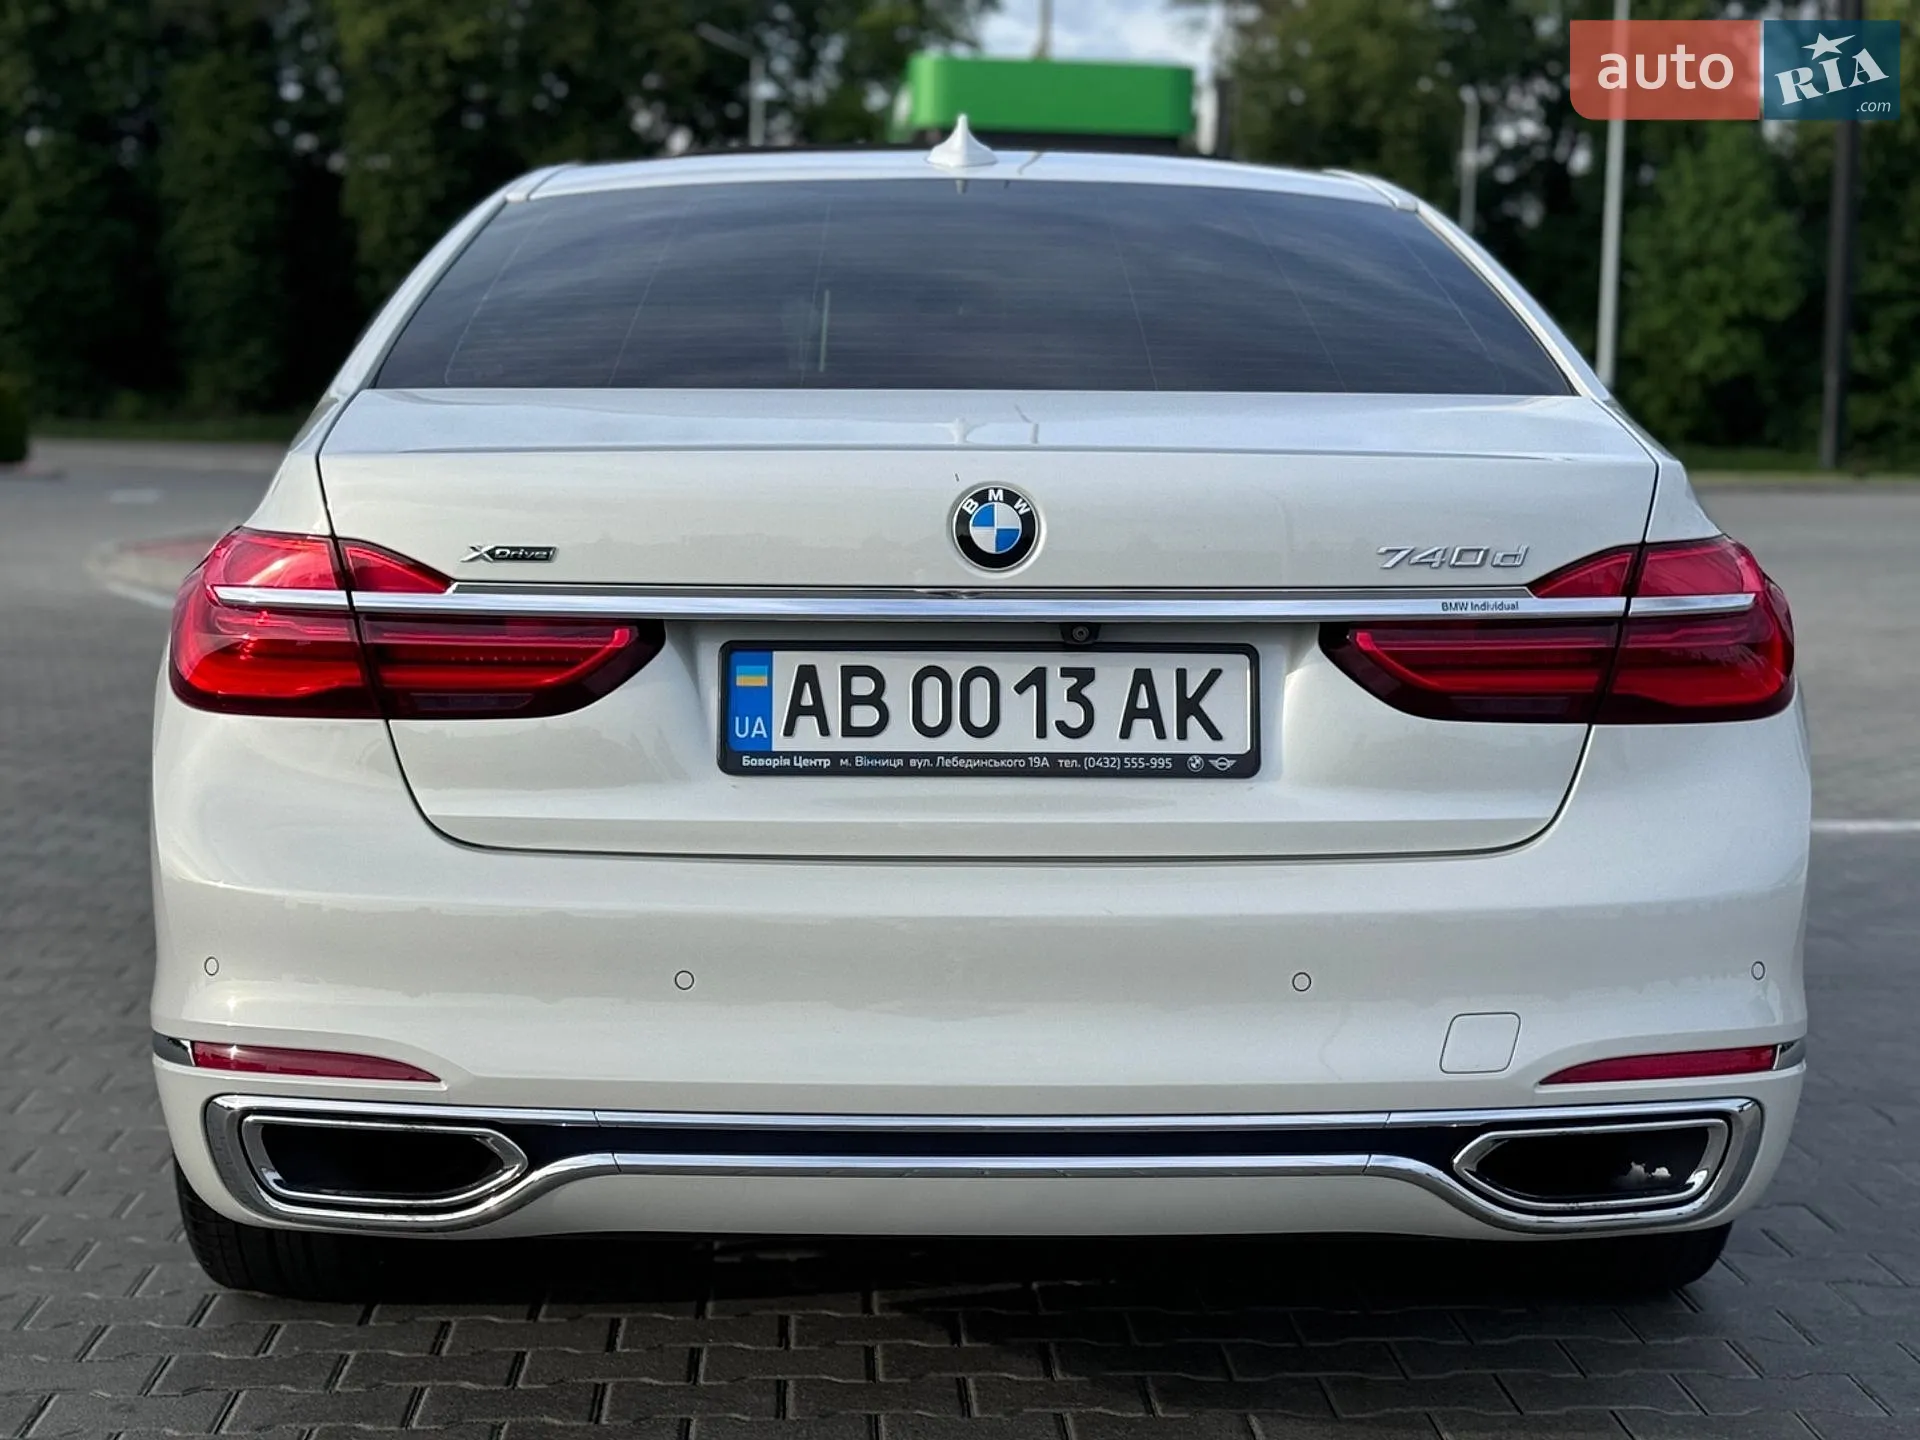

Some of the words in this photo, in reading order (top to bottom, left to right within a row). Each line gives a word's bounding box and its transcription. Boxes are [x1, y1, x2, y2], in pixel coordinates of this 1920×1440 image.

[962, 489, 1031, 516] BMW
[1441, 602, 1469, 612] BMW
[1470, 601, 1519, 611] Individual
[780, 664, 890, 739] AB
[911, 664, 1096, 740] 0013
[1118, 667, 1223, 741] AK
[734, 716, 768, 739] UA
[793, 756, 831, 769] Центр
[839, 757, 852, 767] м.
[855, 756, 904, 768] Вінниця
[909, 758, 934, 769] вул.
[935, 756, 1026, 769] Лебединського
[1057, 758, 1081, 769] тел.
[1083, 756, 1121, 770] (0432)
[1124, 757, 1173, 769] 555-995
